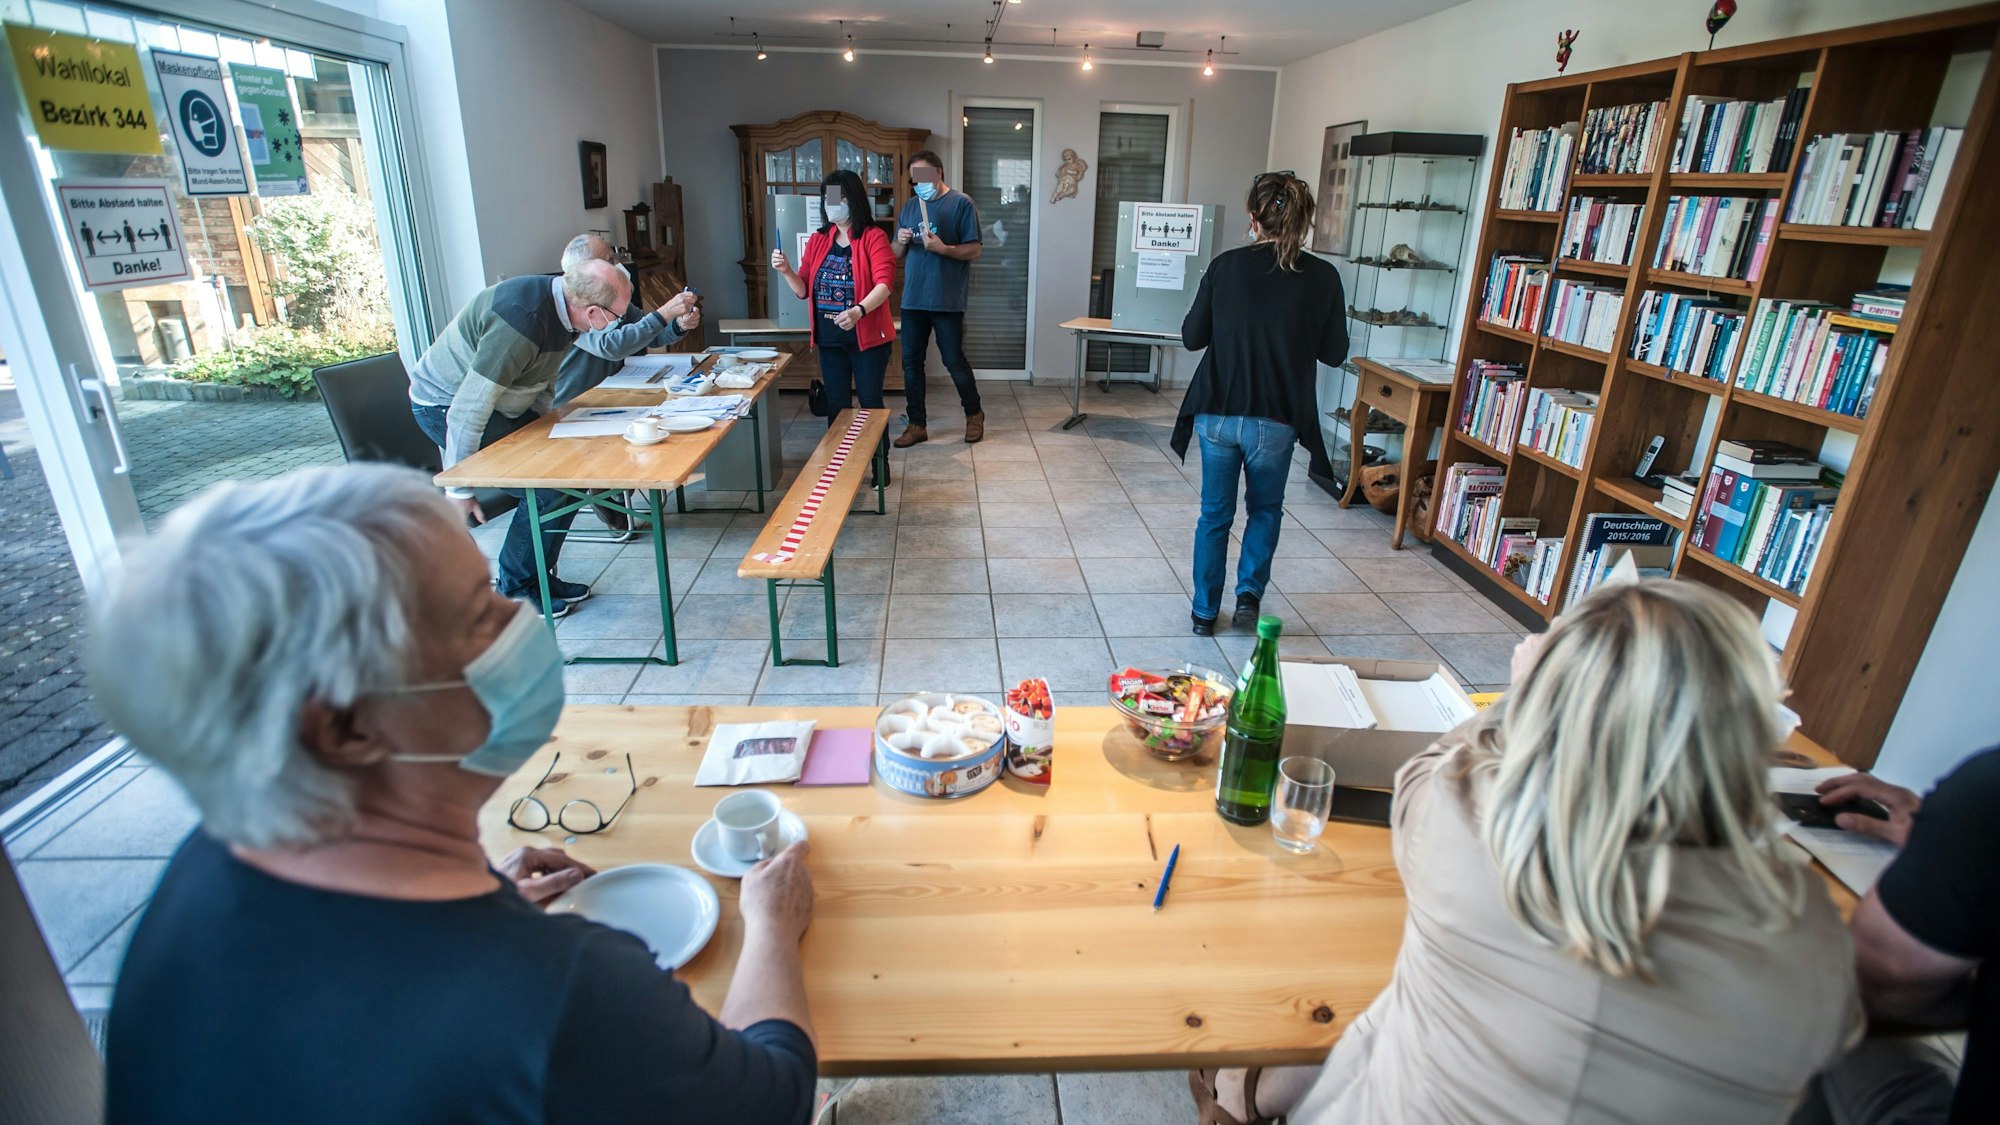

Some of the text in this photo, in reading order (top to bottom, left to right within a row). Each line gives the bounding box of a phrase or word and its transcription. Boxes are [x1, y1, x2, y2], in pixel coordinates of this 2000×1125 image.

[34, 54, 131, 88] Wahllokal
[157, 60, 221, 80] Maskenpflicht
[40, 100, 147, 130] Bezirk 344
[1912, 144, 1926, 167] 2012
[188, 167, 201, 175] Bitte
[202, 168, 218, 176] tragen
[191, 177, 243, 185] Mund-Nasen-Schutz
[70, 197, 164, 209] Bitte Abstand halten
[1151, 239, 1180, 248] Danke!
[113, 258, 162, 276] Danke!
[1868, 306, 1901, 317] MALLORCA
[1602, 520, 1663, 531] Deutschland
[1606, 532, 1651, 541] 2015/2016
[1147, 703, 1170, 712] kinder
